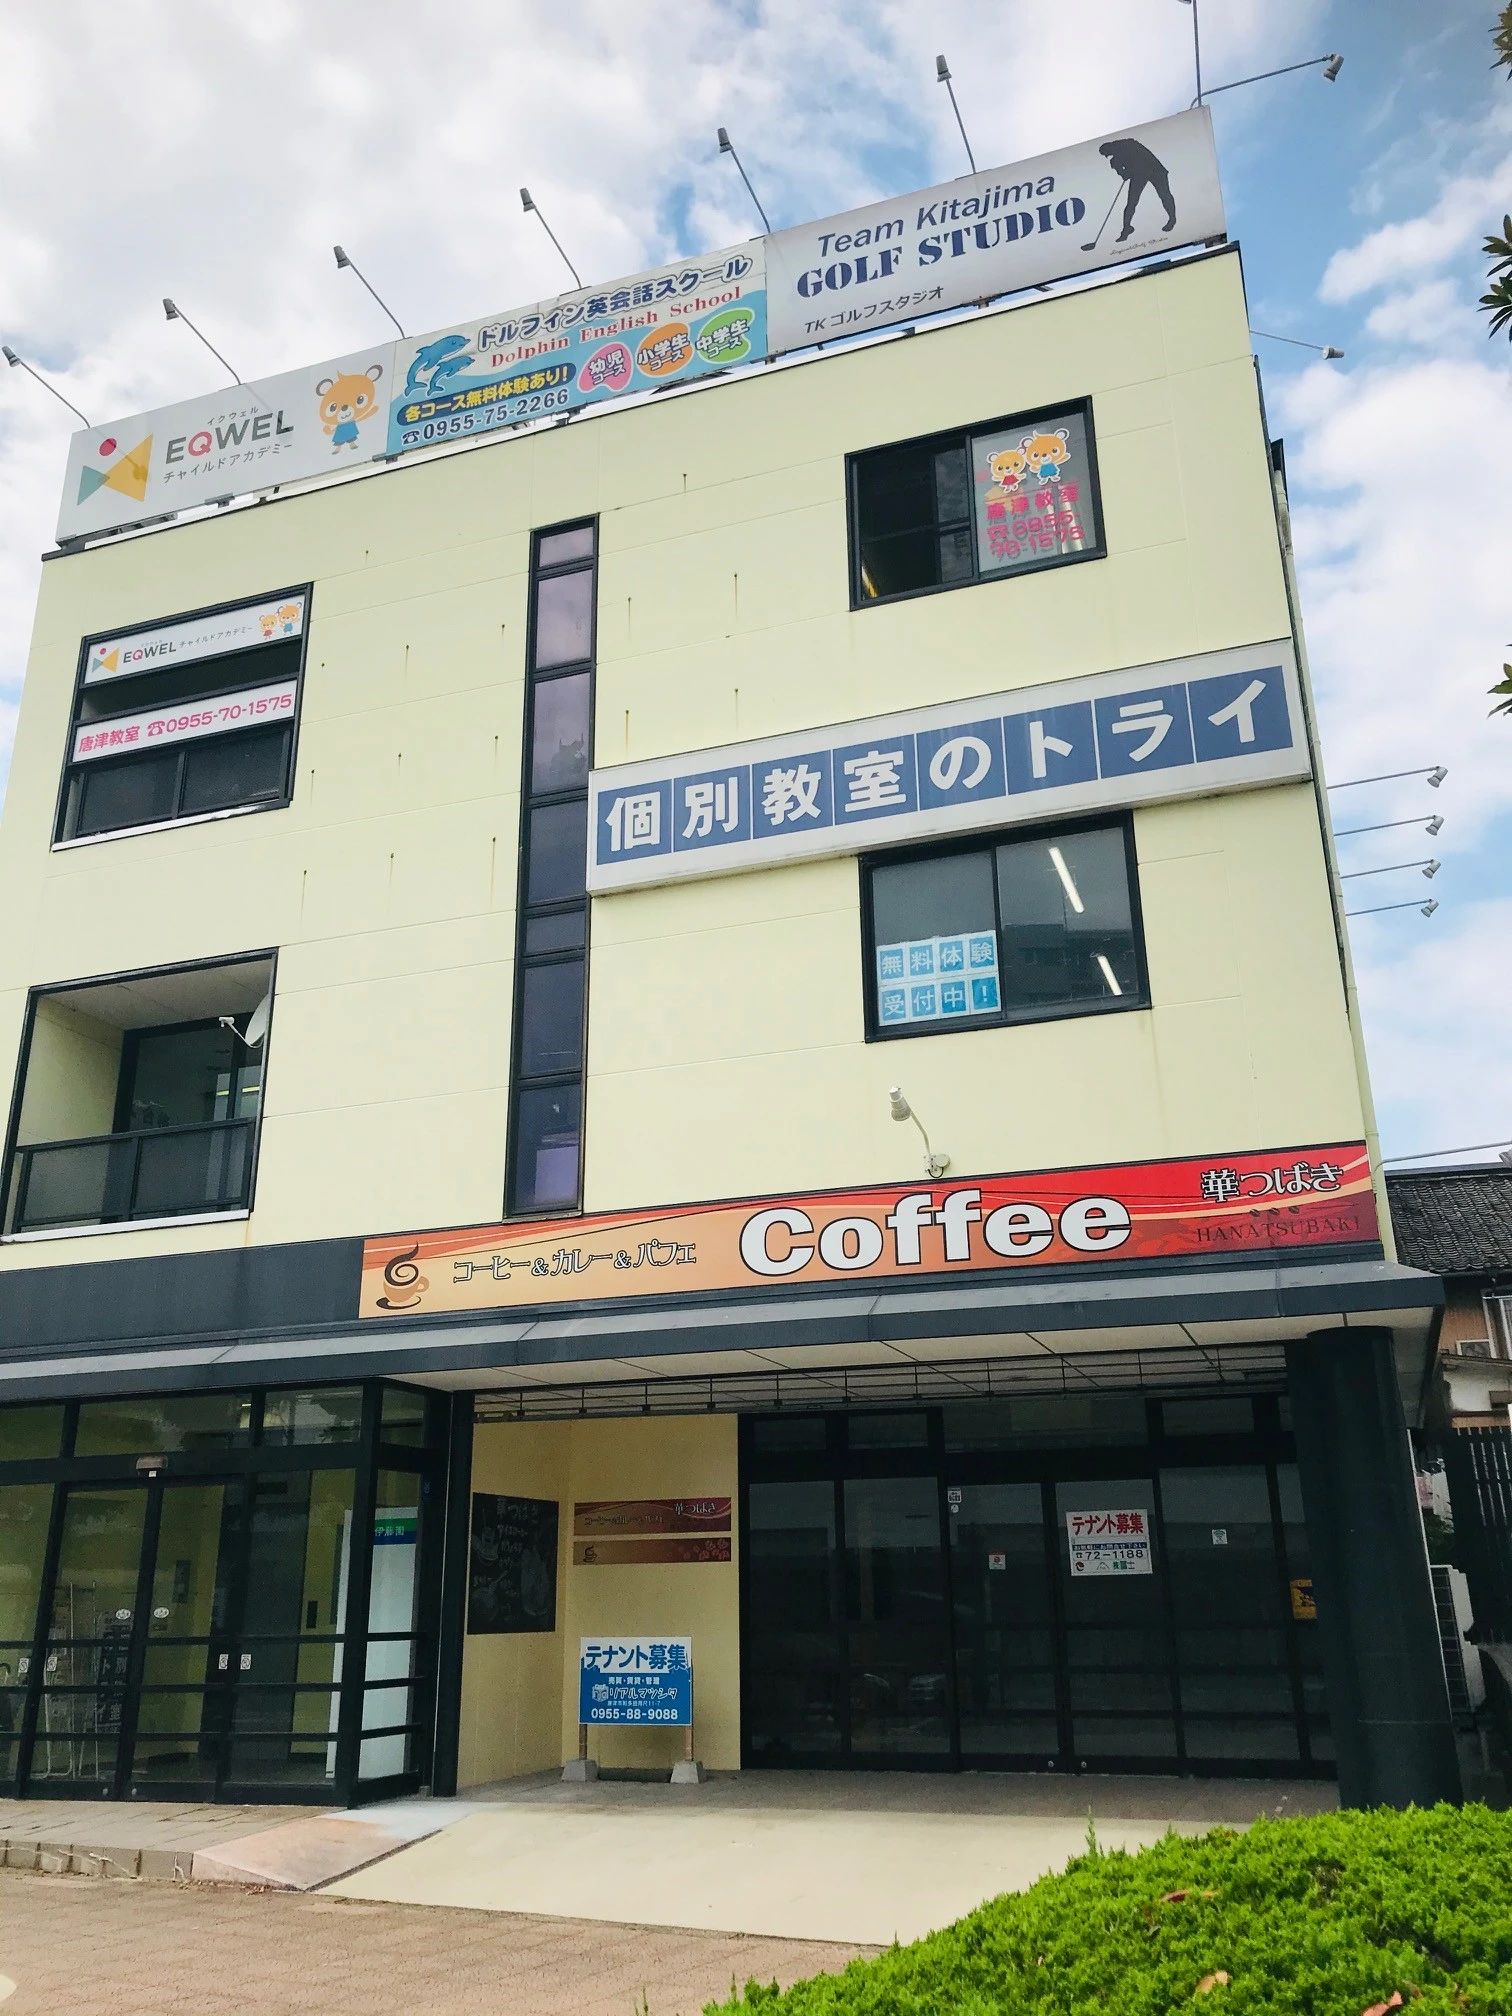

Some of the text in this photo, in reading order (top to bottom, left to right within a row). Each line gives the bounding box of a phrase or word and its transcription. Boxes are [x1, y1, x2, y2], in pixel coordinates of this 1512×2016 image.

[817, 175, 1056, 258] Team Kitajima
[796, 196, 1087, 299] GOLF STUDIO
[479, 256, 752, 351] ドルフィン英会話スクール
[804, 286, 945, 334] TK ゴルフスタジオ
[491, 286, 741, 368] Dolphin English School
[696, 318, 750, 352] 中学生
[589, 349, 626, 375] 幼児
[637, 332, 690, 366] 小学生
[650, 350, 685, 371] コース
[707, 335, 744, 359] コース
[592, 365, 626, 385] コース
[207, 406, 259, 426] イクウェル
[423, 388, 569, 440] 0955-75-2266
[165, 410, 295, 464] EQWEL
[163, 443, 292, 484] チャイルドアカデミー
[123, 641, 177, 664] EQWEL
[78, 693, 293, 753] 唐津教室 0955-70-1575
[605, 678, 1267, 852] 個別教室のトライ
[882, 941, 993, 975] 無料体験
[1200, 1161, 1344, 1204] 華つばき
[739, 1187, 1133, 1277] Coffee
[1195, 1215, 1360, 1243] HANATSUBAKI
[1072, 1512, 1144, 1535] テナント募集
[1085, 1550, 1144, 1560] 72-1188
[585, 1644, 687, 1670] テナント募集
[590, 1708, 679, 1720] 0955-88-9088
